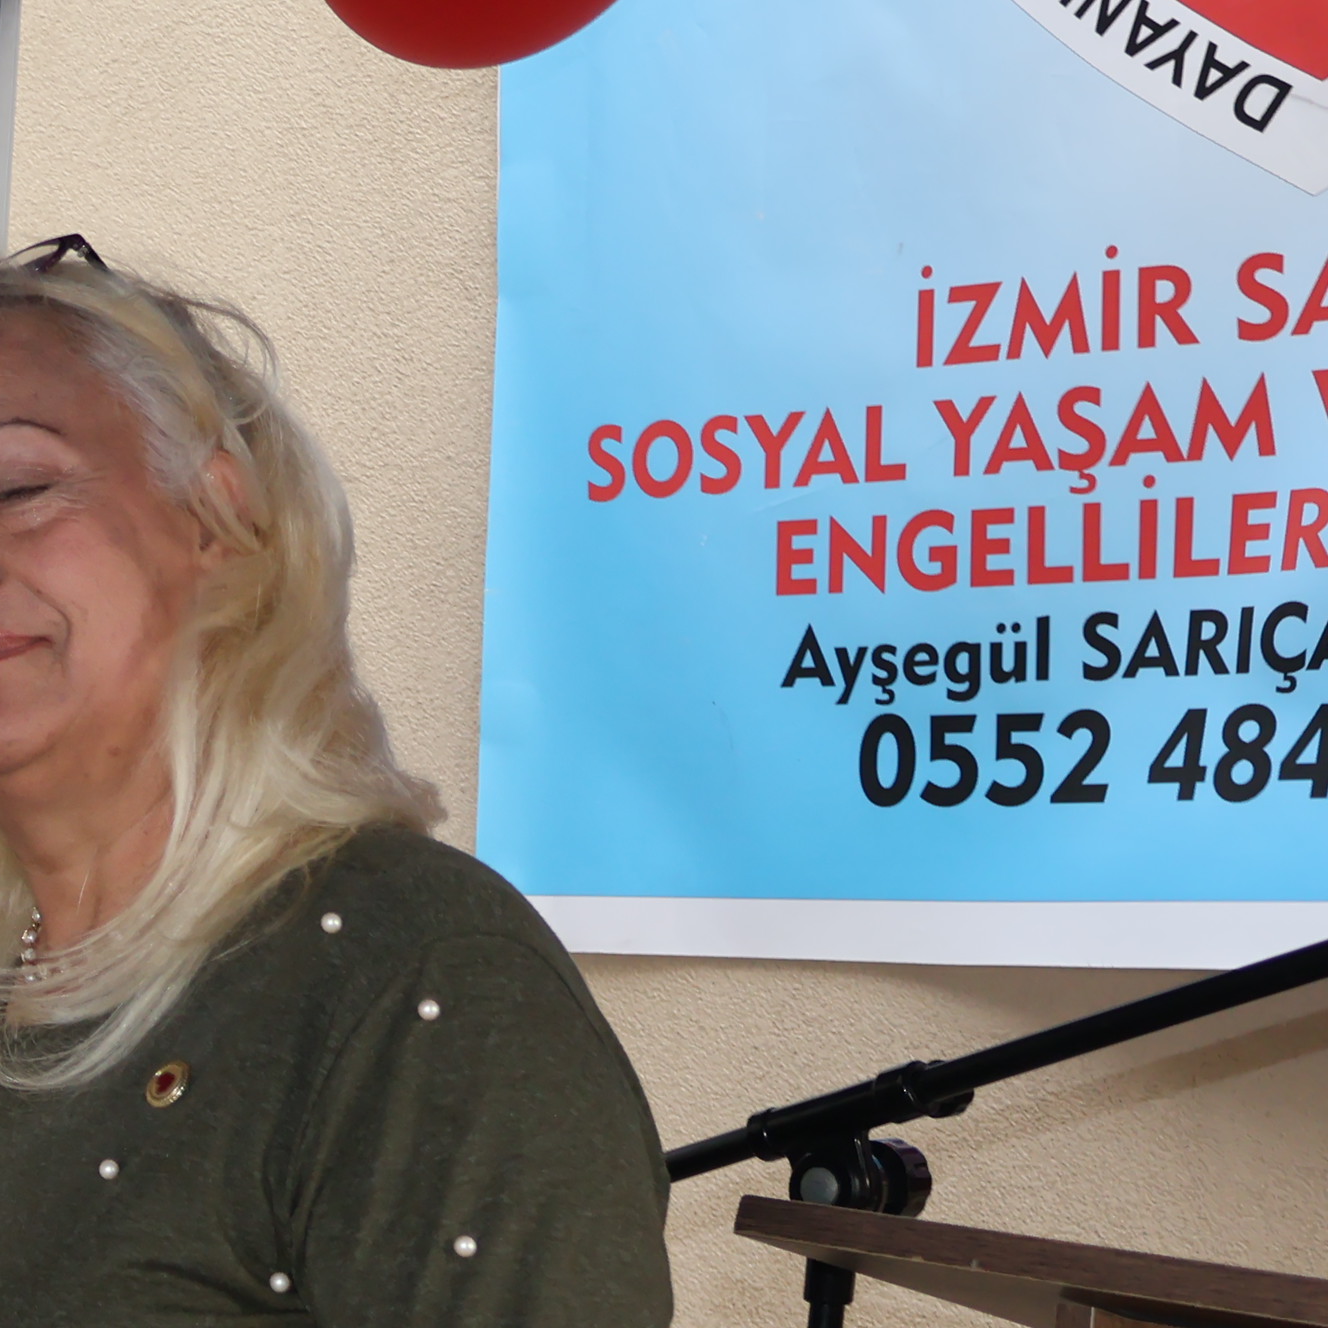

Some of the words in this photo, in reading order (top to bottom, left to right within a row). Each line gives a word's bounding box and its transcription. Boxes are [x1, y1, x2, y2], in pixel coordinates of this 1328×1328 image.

[915, 245, 1201, 368] İZMİR
[587, 404, 907, 503] SOSYAL
[933, 372, 1277, 495] YAŞAM
[775, 474, 1328, 597] ENGELLİLER
[781, 614, 1051, 706] Ayşegül
[858, 707, 1112, 808] 0552
[1147, 703, 1328, 804] 484
